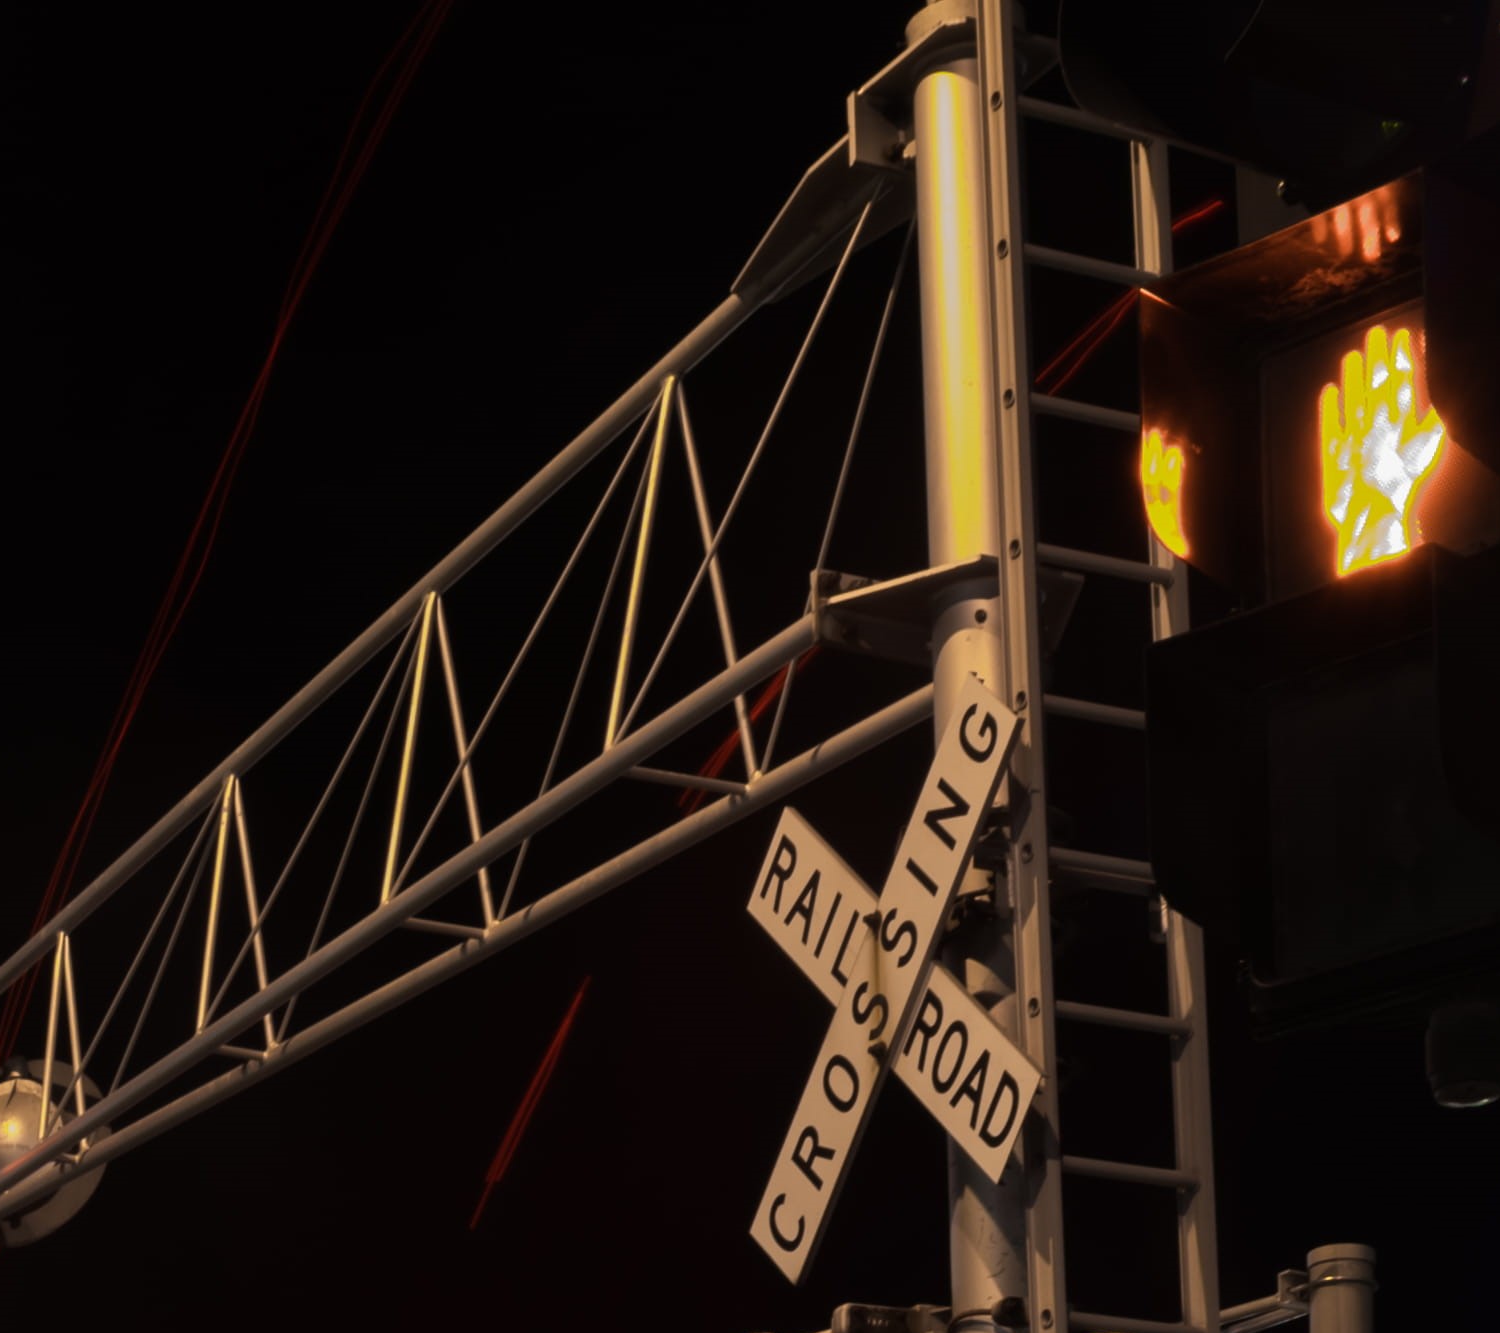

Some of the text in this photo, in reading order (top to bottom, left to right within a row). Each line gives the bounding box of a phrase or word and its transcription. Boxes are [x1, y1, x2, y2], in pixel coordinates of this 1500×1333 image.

[759, 834, 1021, 1149] RAIL ROAD
[768, 702, 1000, 1254] CROSSING
